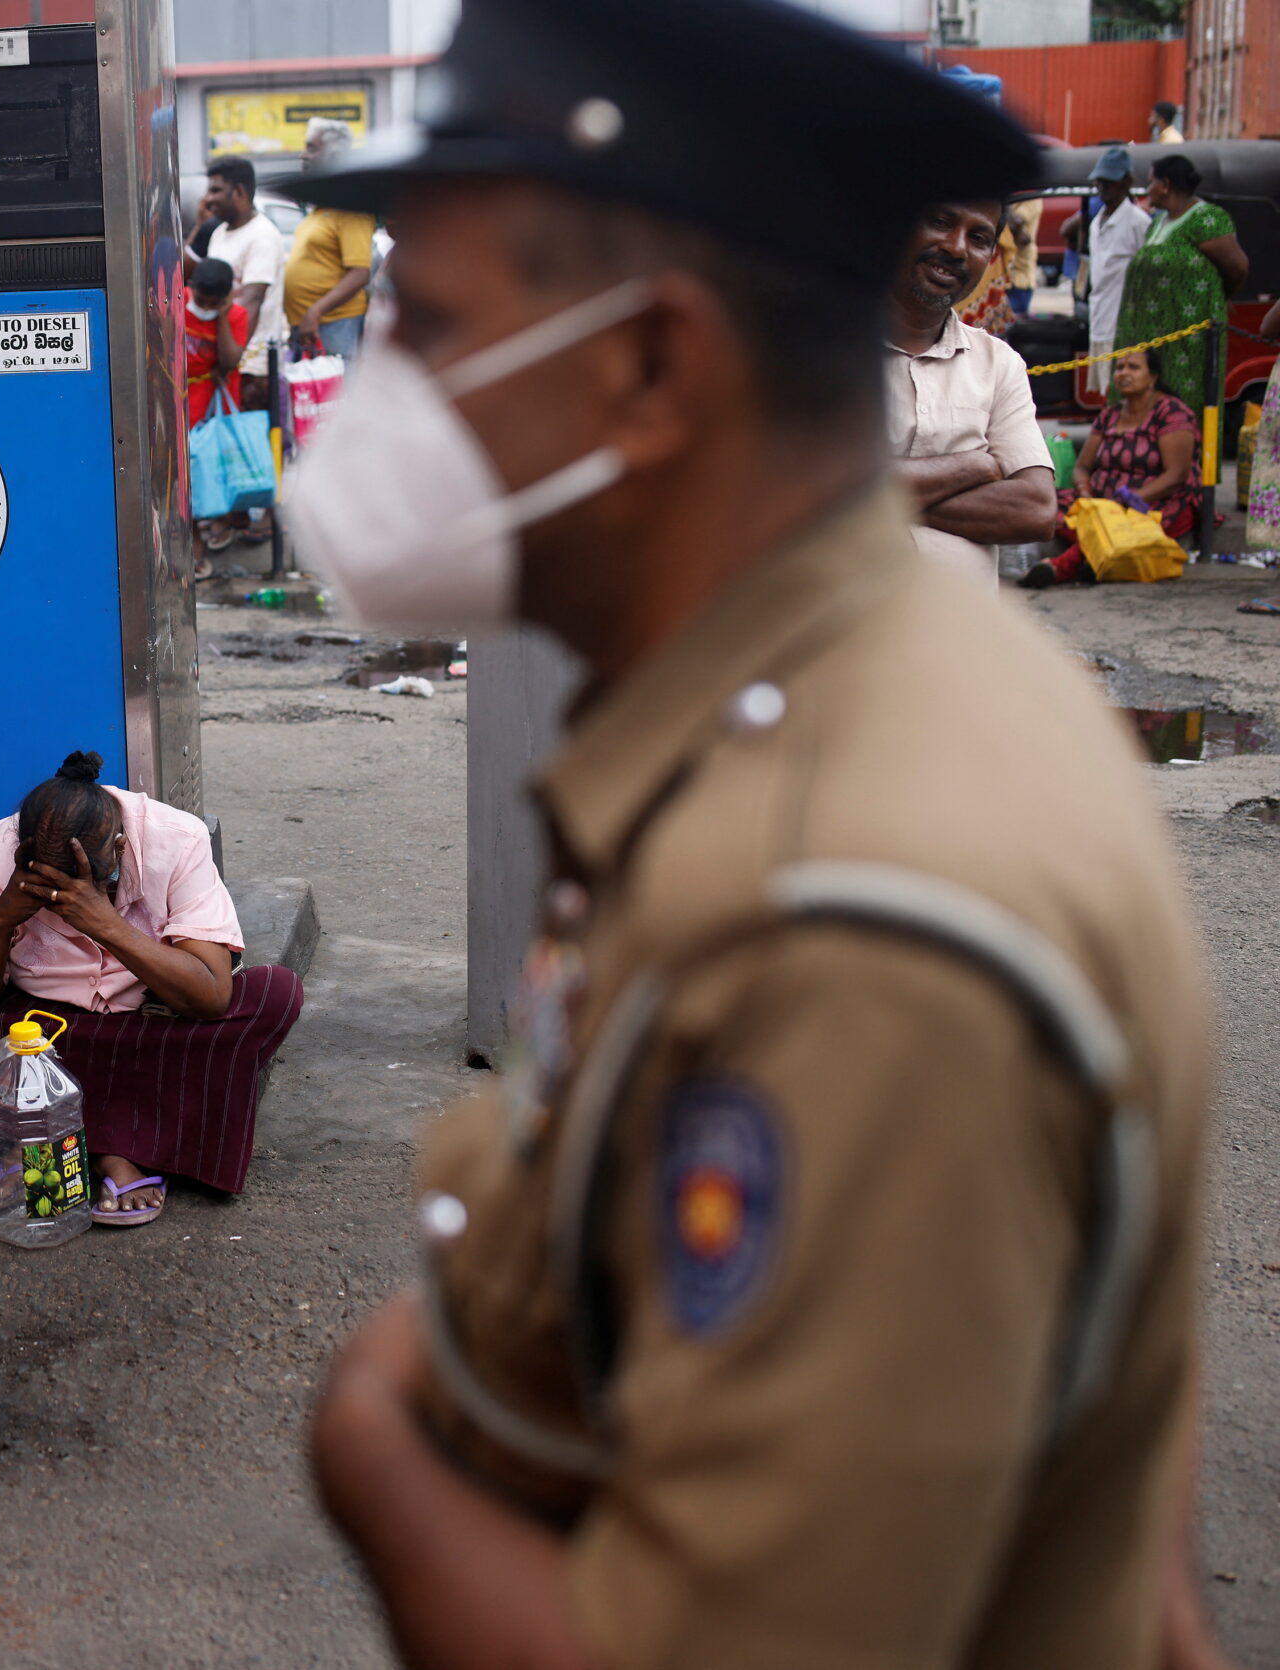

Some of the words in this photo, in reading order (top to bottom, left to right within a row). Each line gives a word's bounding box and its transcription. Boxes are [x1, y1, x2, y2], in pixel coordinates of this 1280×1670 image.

[27, 317, 81, 332] DIESEL
[62, 1146, 80, 1161] WHITE
[64, 1160, 82, 1178] OIL
